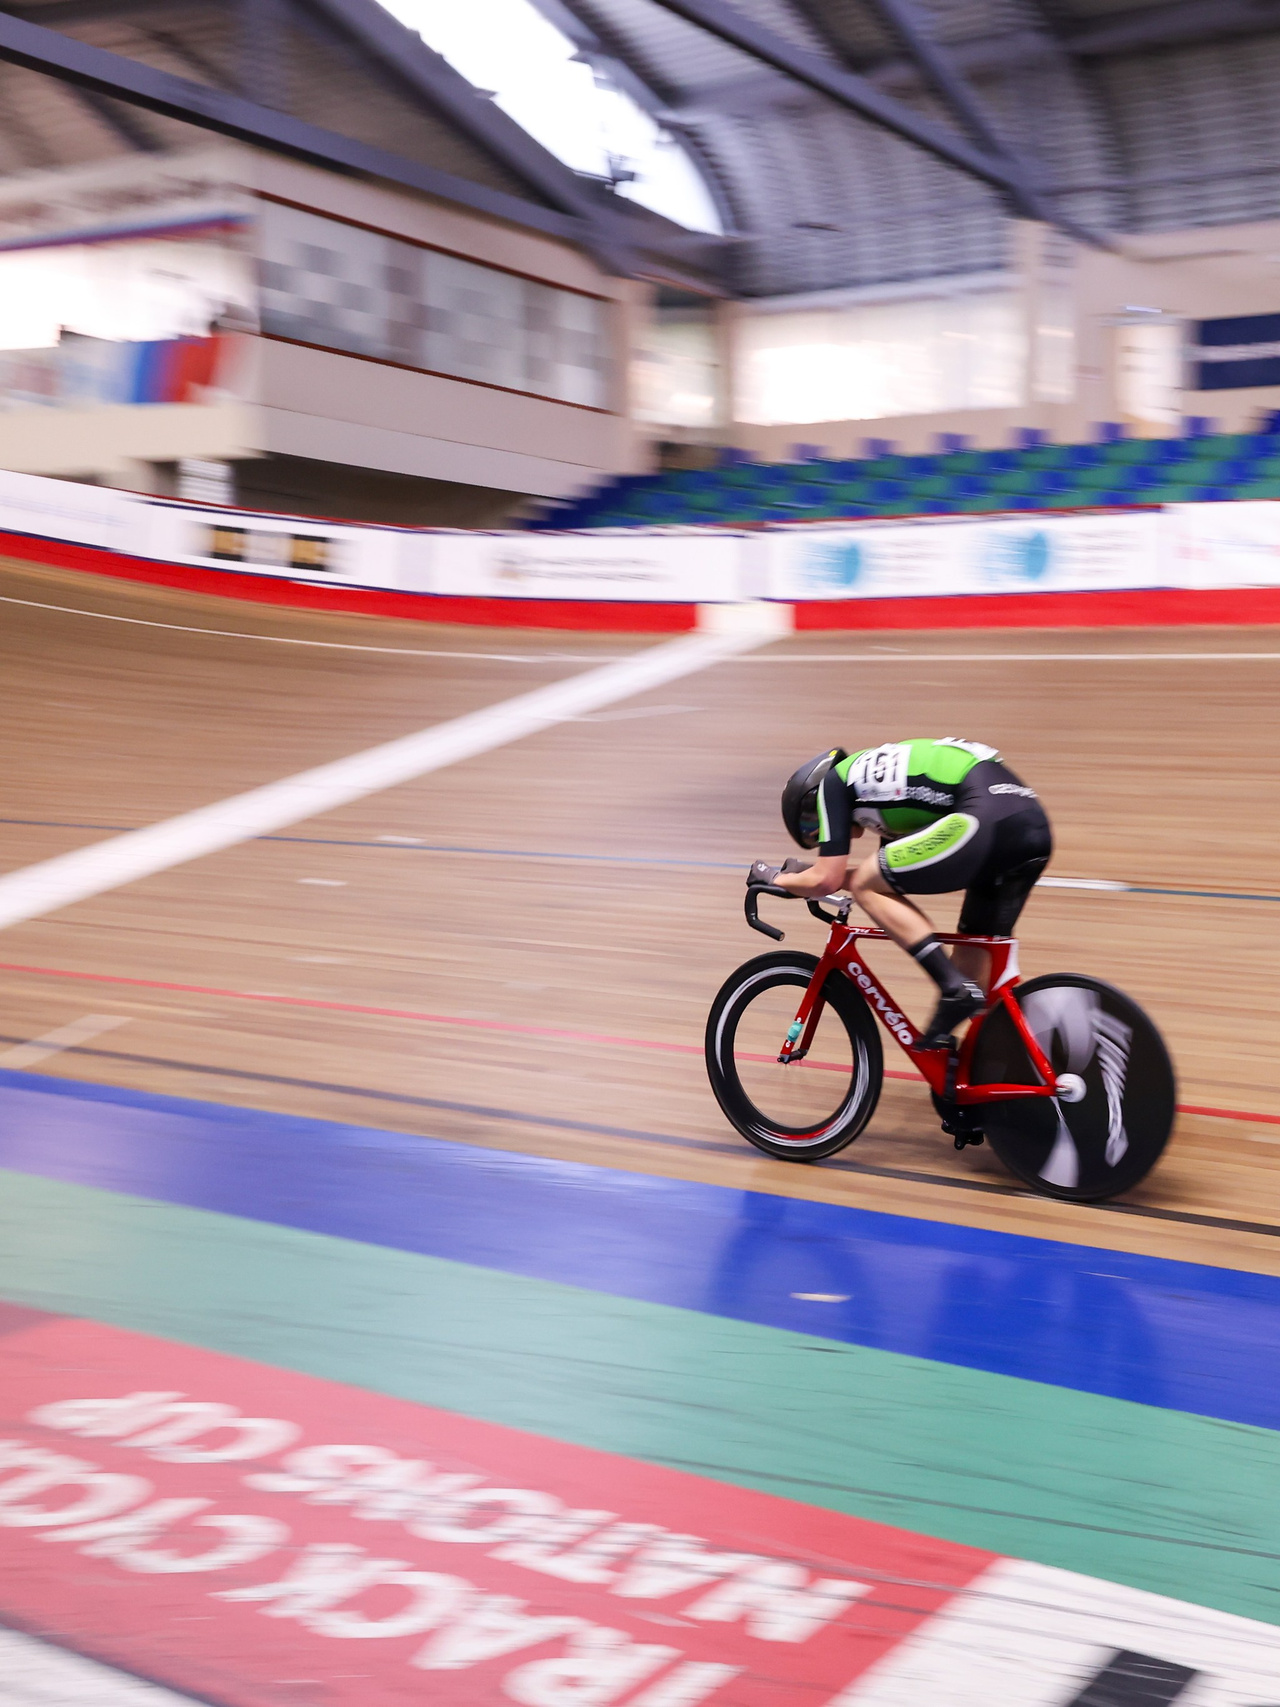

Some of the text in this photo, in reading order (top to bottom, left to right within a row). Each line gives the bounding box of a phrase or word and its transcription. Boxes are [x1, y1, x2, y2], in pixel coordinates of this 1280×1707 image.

[847, 961, 914, 1046] cervélo
[24, 1391, 876, 1642] NATIONS CUP
